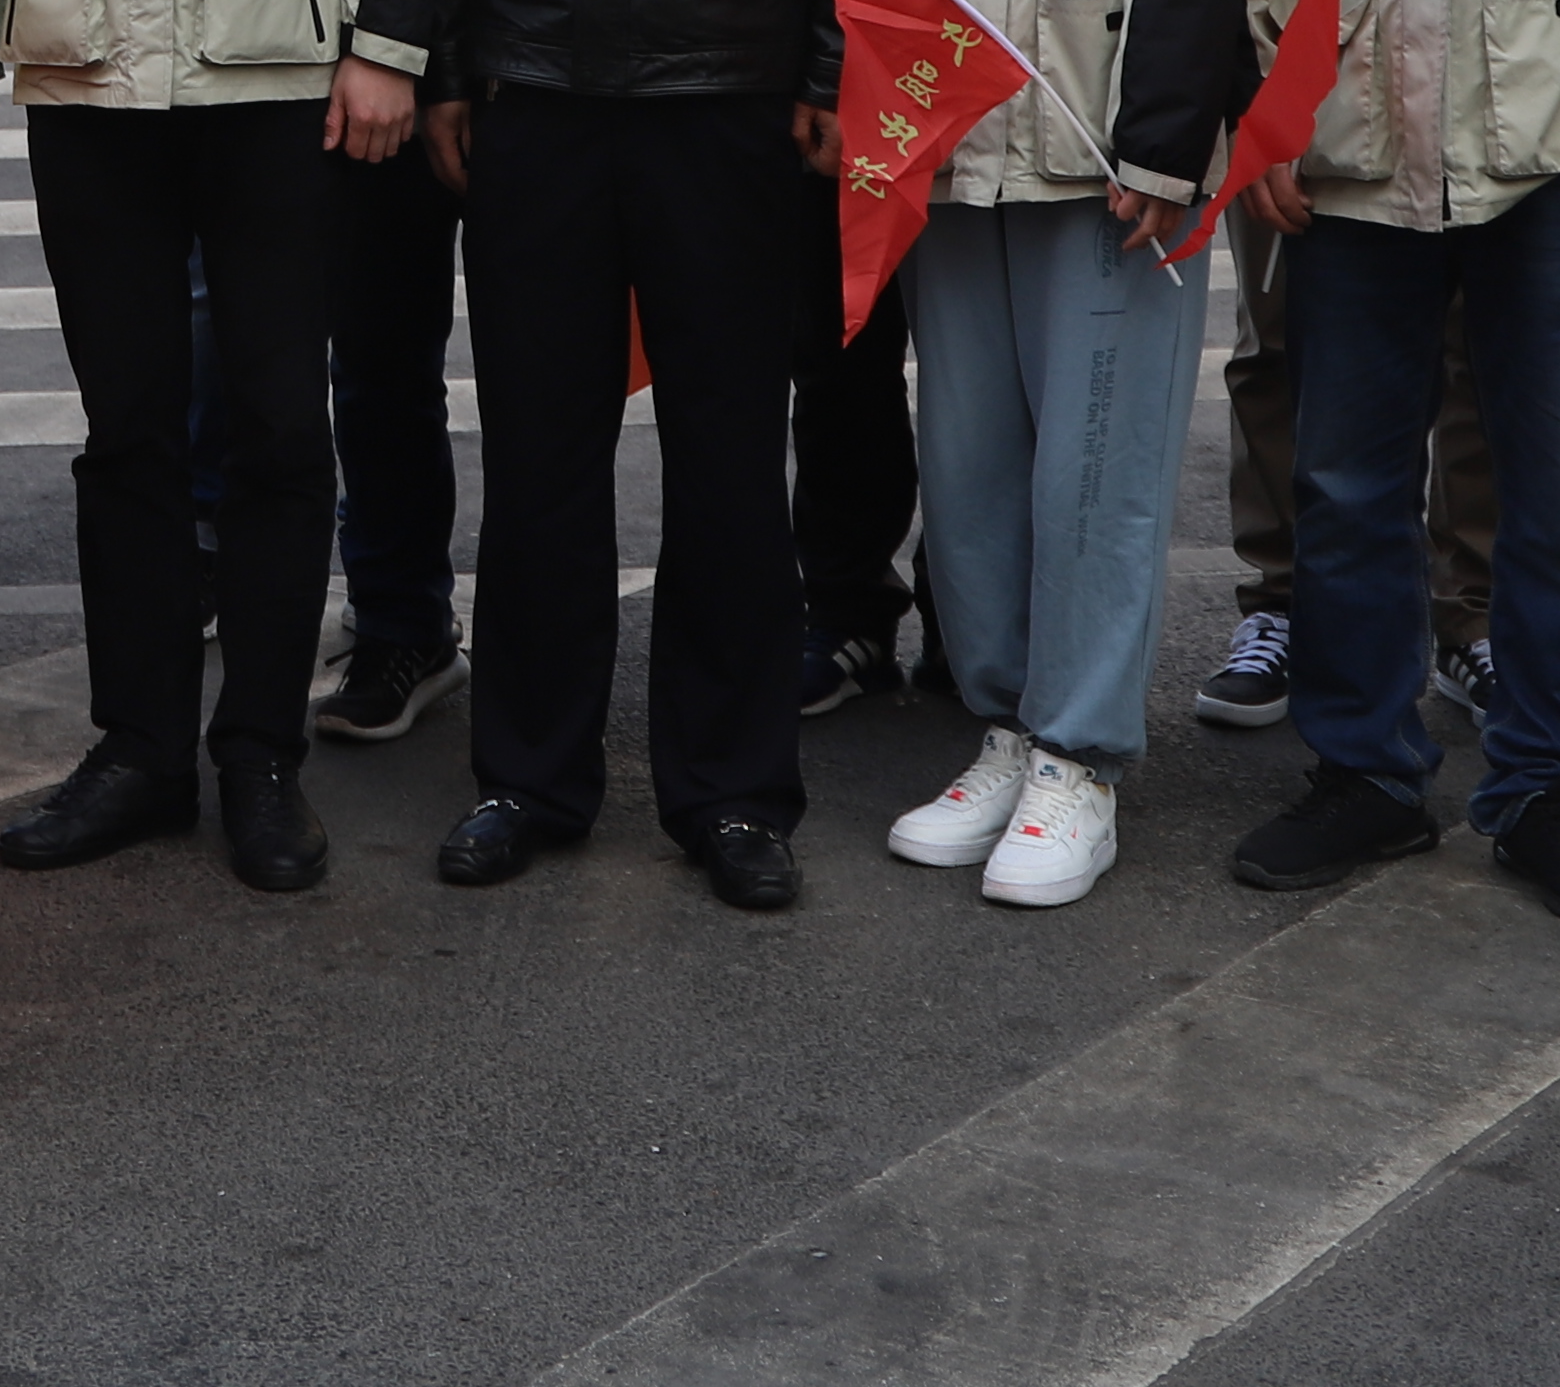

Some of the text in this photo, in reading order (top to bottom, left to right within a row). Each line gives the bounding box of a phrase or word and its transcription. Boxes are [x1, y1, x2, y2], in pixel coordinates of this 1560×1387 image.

[1106, 346, 1117, 365] TO
[1089, 350, 1105, 397] BASED
[1100, 371, 1115, 413] BUILD
[1087, 402, 1100, 424] ON
[1098, 418, 1109, 437] UP
[1083, 430, 1098, 458] THE
